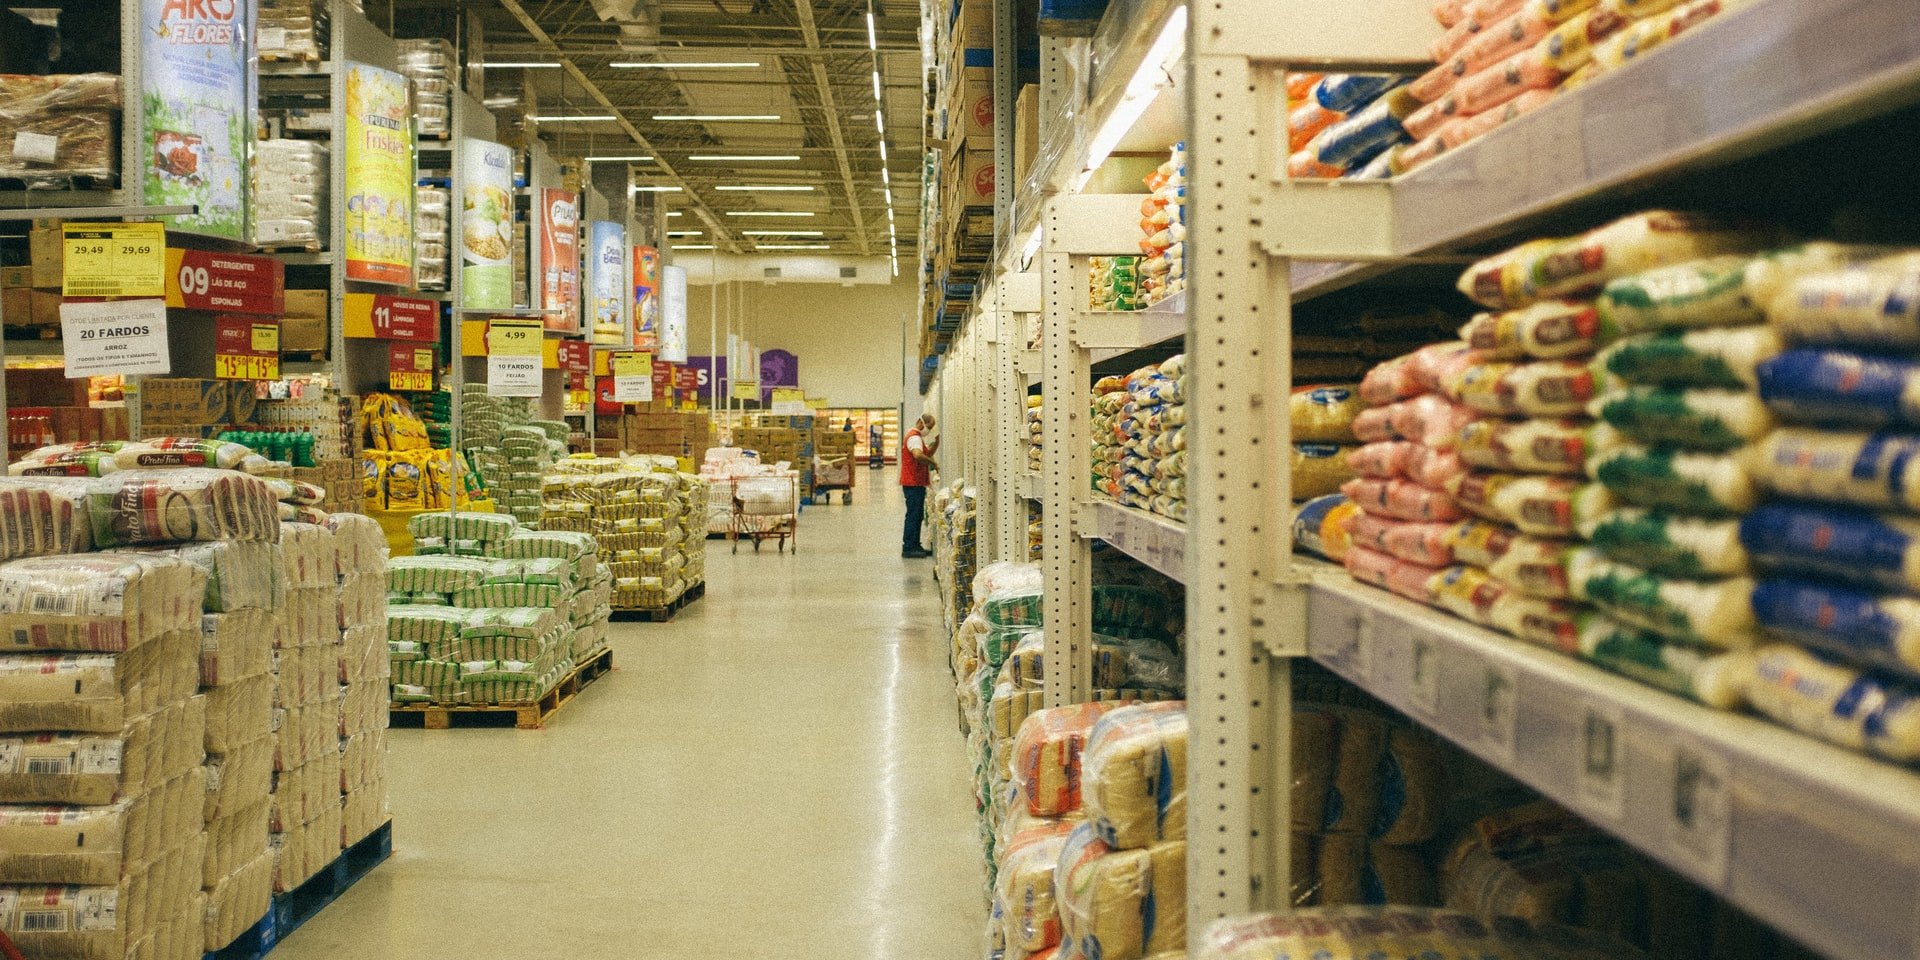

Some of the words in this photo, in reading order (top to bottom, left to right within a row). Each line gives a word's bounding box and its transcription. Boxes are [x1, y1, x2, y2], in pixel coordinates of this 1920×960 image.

[170, 23, 232, 45] FLORES
[366, 129, 404, 155] Friskies
[74, 246, 104, 255] 29,49
[122, 246, 151, 256] 29,69
[211, 260, 255, 272] DETERGENTES
[180, 265, 209, 295] 09
[211, 297, 243, 307] ESPONJAS
[131, 312, 157, 320] CLIENTE
[375, 307, 390, 328] 11
[80, 330, 95, 339] 20
[99, 325, 149, 338] FARDOS
[505, 331, 526, 340] 4,99
